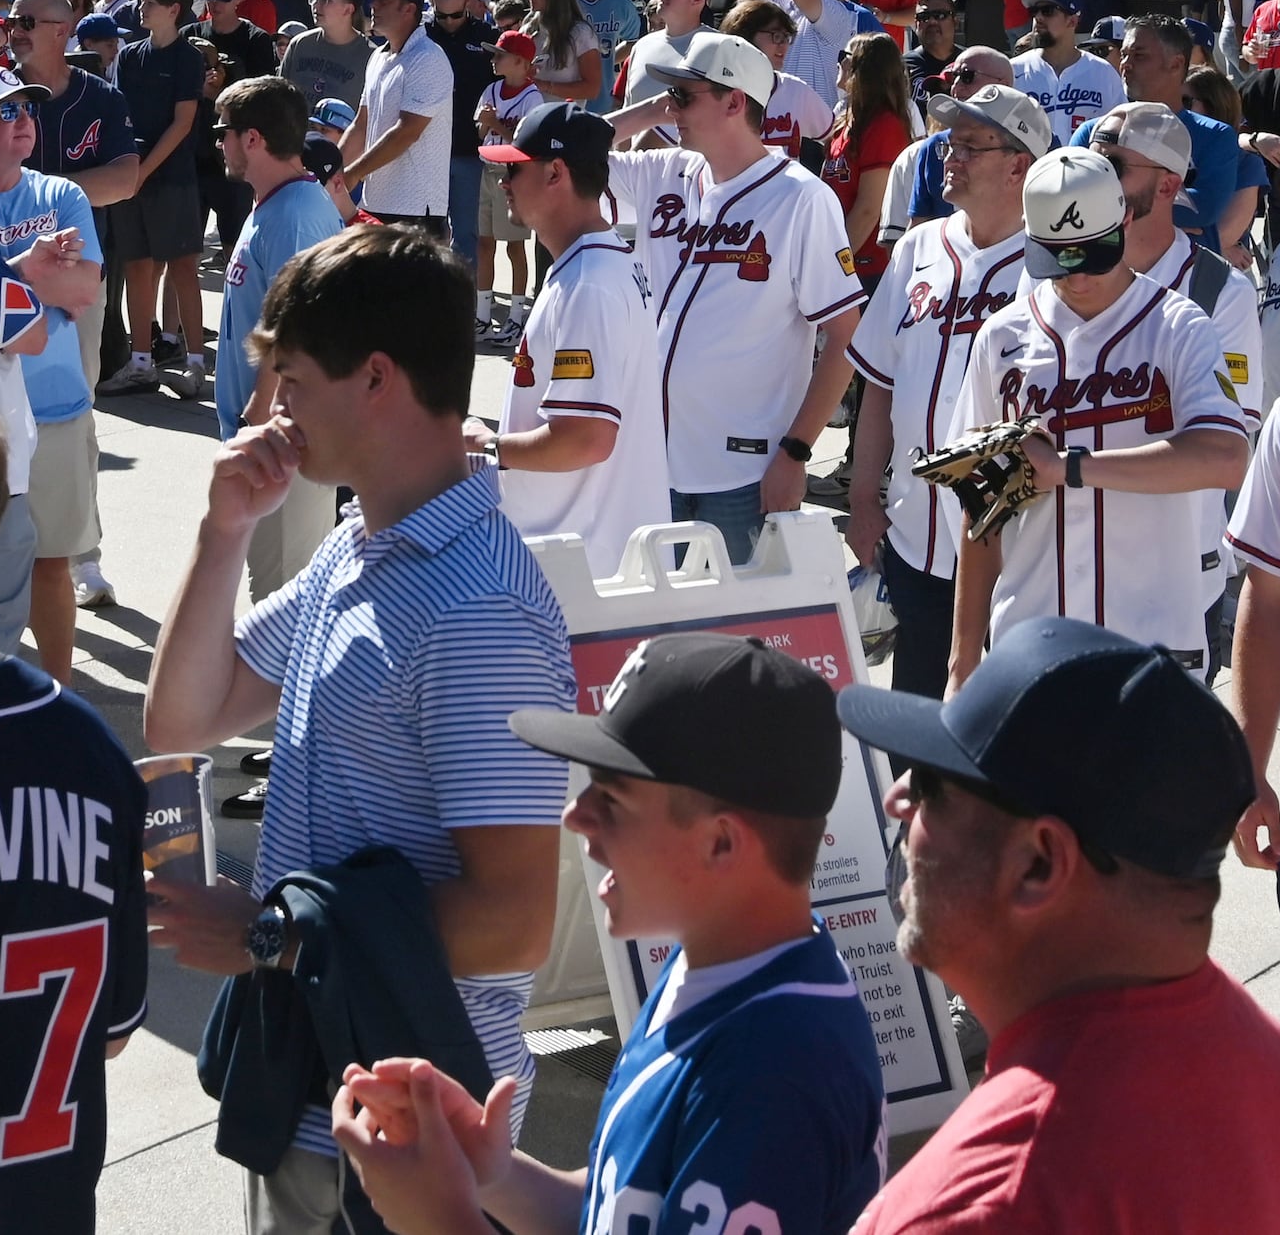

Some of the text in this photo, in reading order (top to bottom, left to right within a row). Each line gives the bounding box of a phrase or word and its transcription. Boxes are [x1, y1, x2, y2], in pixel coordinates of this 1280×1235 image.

[650, 193, 754, 248] Braves
[999, 361, 1150, 425] Braves
[763, 633, 793, 649] ARK
[822, 855, 860, 872] strollers
[817, 870, 861, 891] permitted
[841, 939, 898, 962] who have
[858, 961, 894, 981] Truist
[863, 983, 903, 1003] not be
[867, 1003, 907, 1024] to exit
[896, 1025, 917, 1041] the
